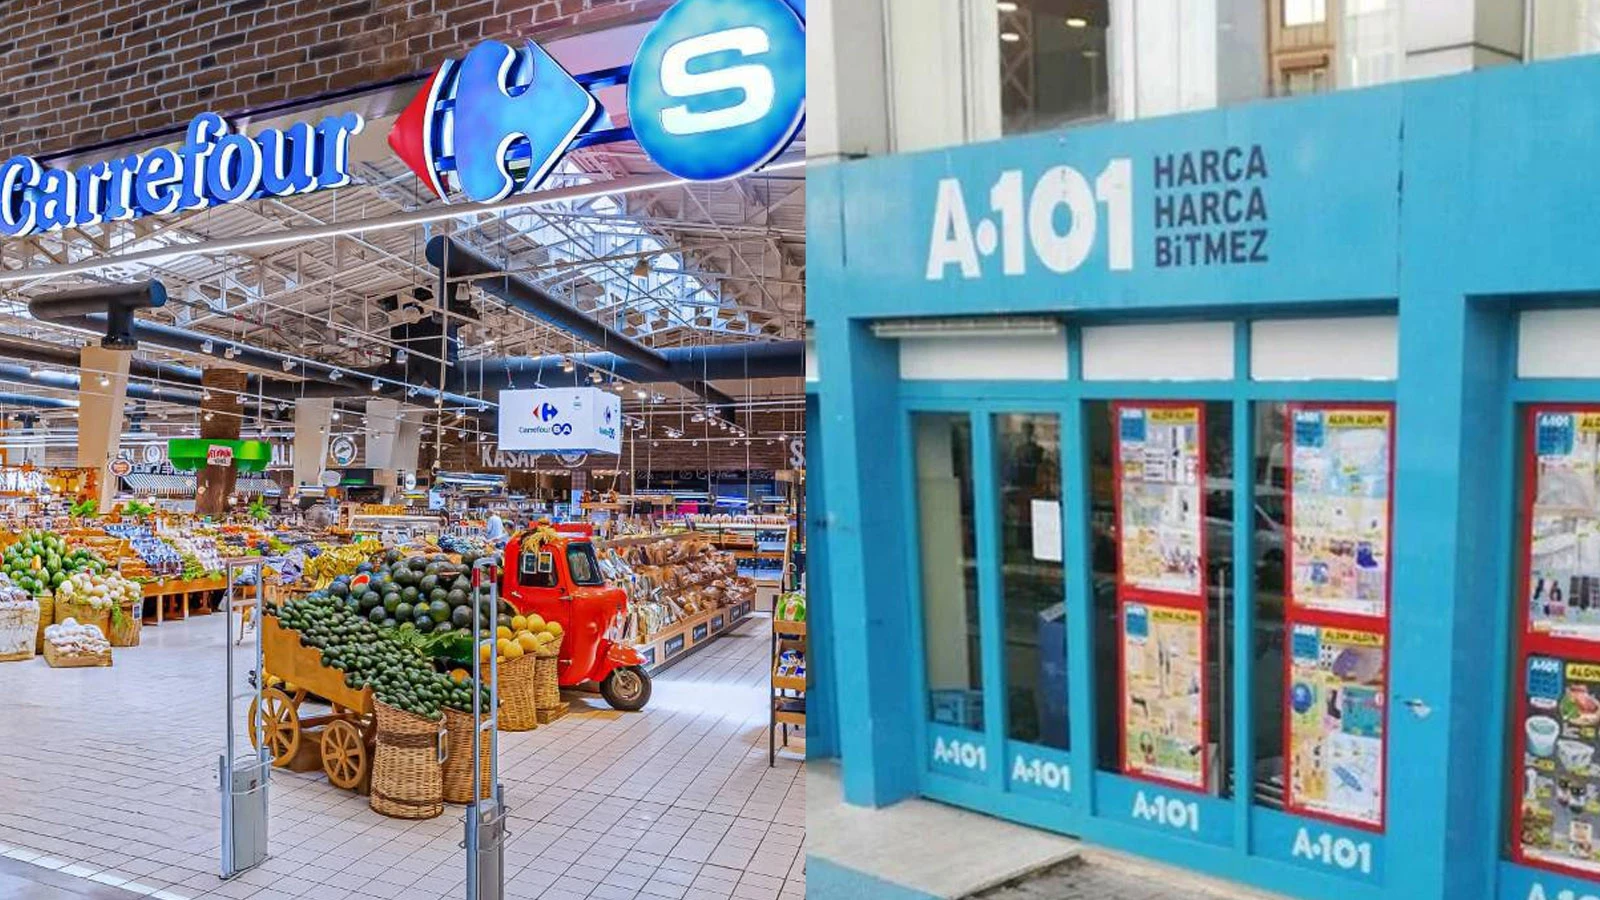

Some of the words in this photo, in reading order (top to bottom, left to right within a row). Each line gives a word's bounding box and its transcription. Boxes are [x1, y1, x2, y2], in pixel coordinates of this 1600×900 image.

[0, 111, 364, 236] Carrefour
[660, 26, 775, 135] S
[1153, 145, 1269, 189] HARCA
[1153, 187, 1269, 229] HARCA
